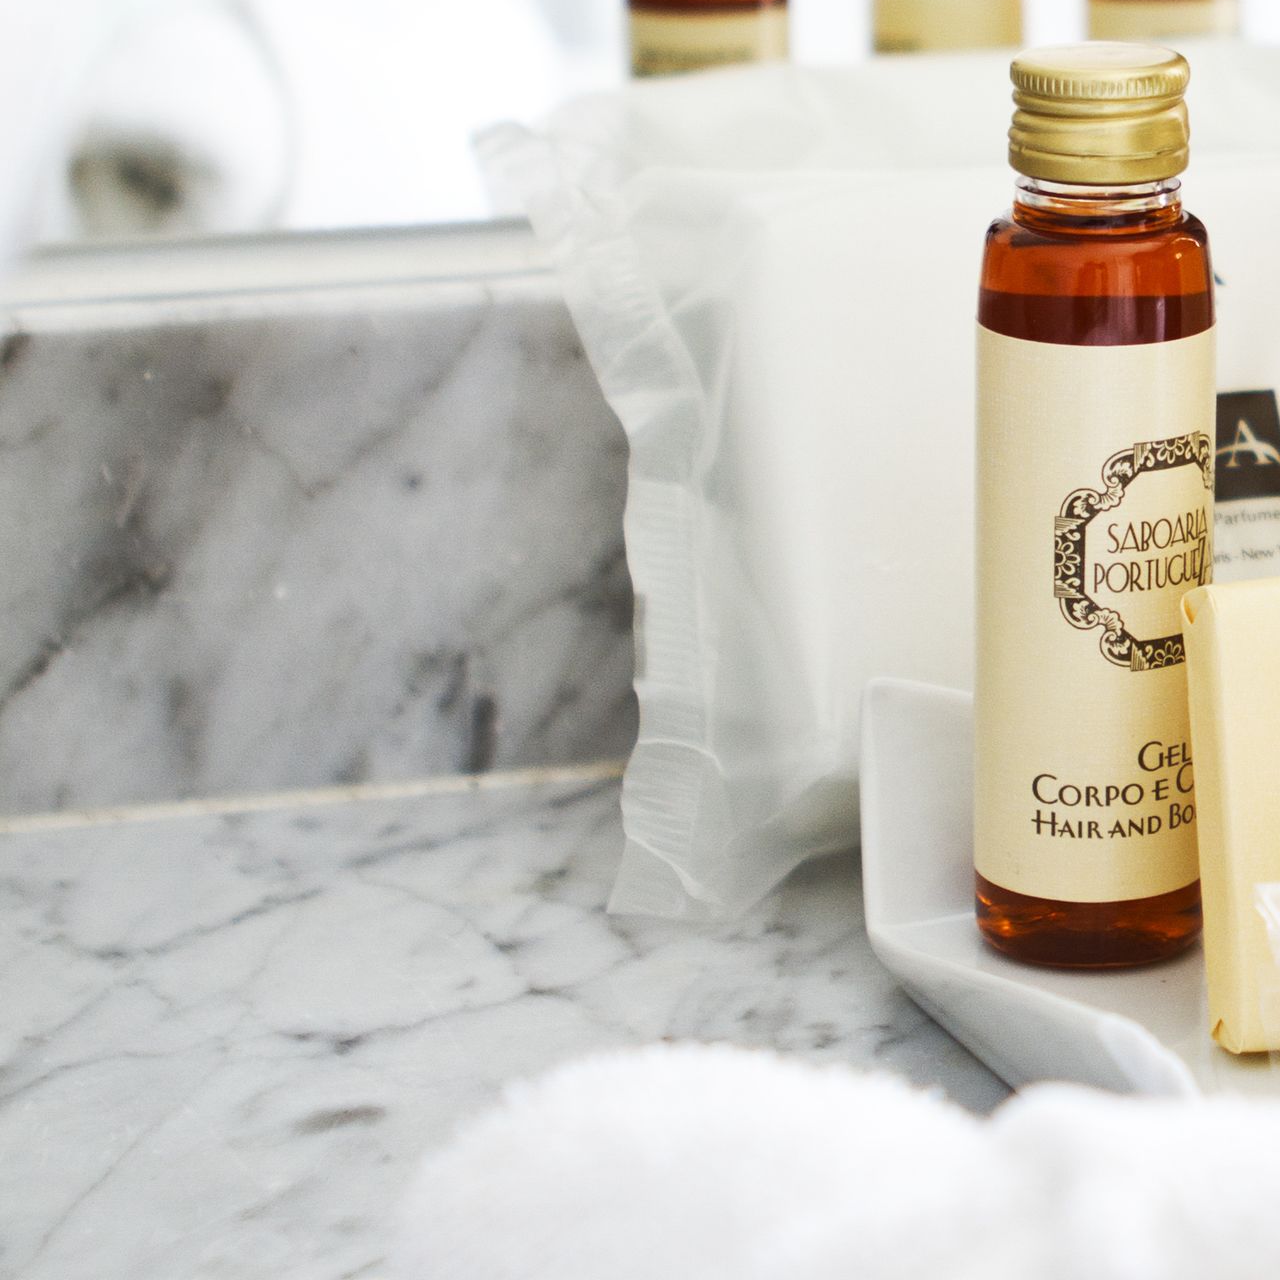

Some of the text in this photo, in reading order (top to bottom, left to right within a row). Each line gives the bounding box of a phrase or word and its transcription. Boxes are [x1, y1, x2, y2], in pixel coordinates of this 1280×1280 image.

[1107, 505, 1208, 554] SABOARIA
[1241, 548, 1275, 563] New
[1137, 740, 1192, 772] GEL
[1031, 773, 1145, 807] CORPO
[1151, 778, 1170, 802] E
[1031, 802, 1197, 840] HAIR AND BO
